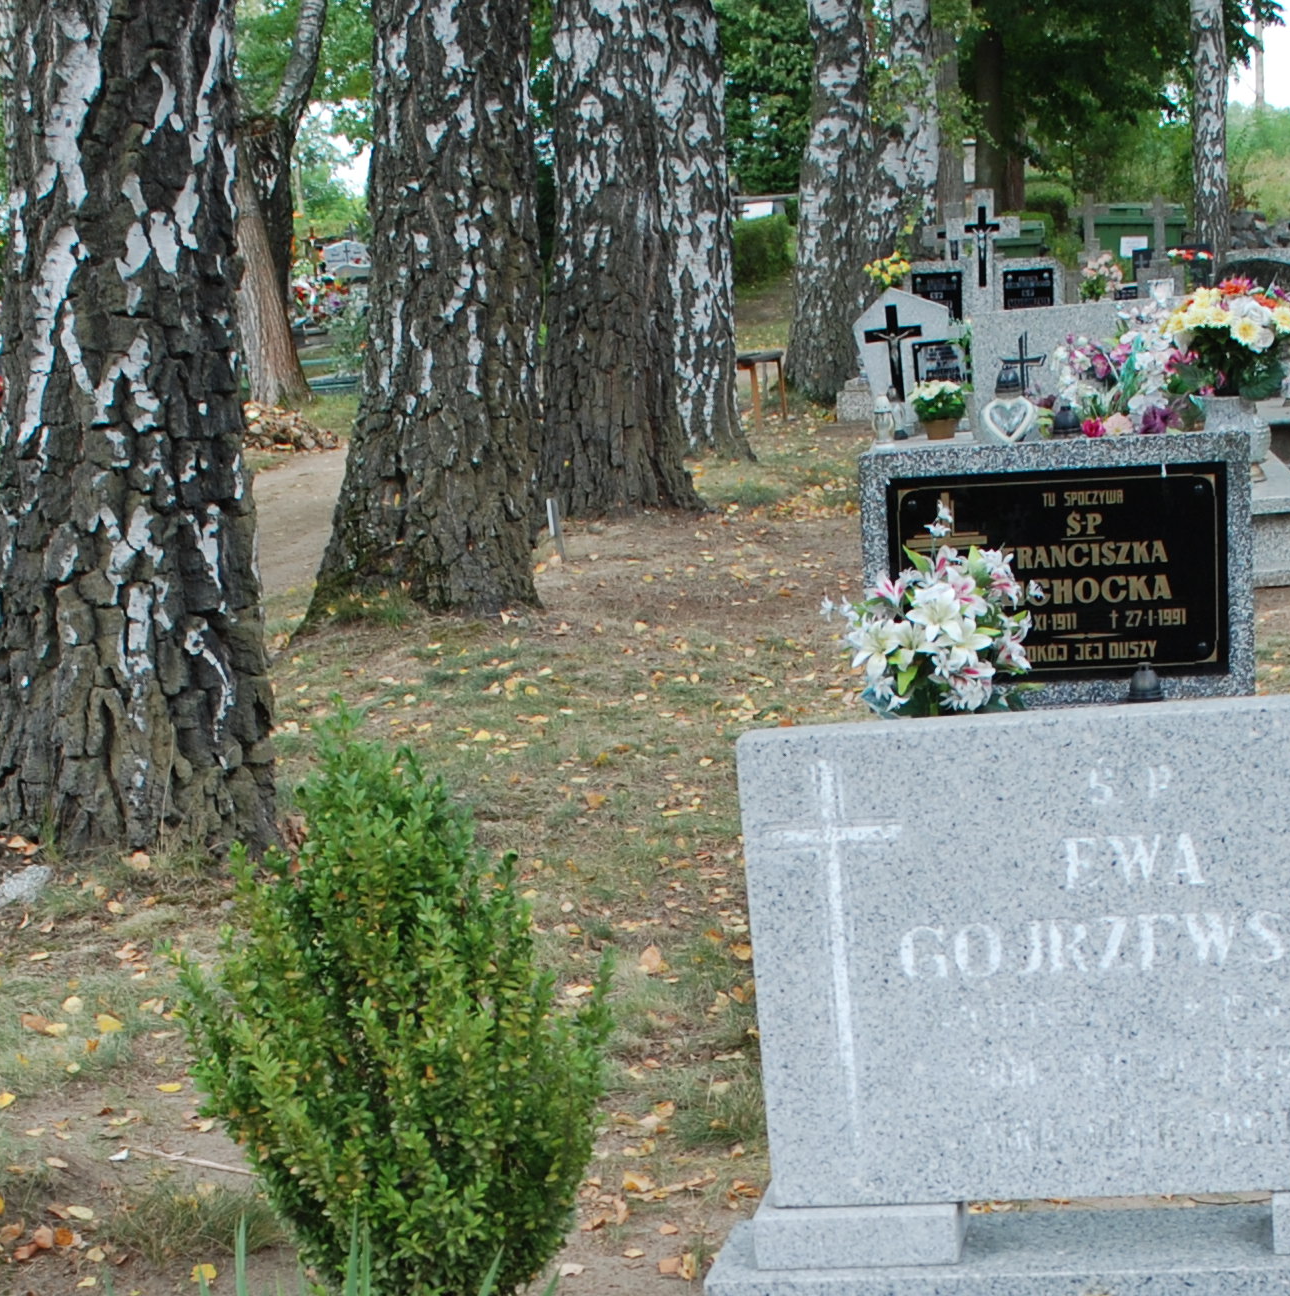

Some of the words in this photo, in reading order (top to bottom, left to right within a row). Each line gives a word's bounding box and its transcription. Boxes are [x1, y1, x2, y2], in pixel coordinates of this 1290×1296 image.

[1043, 493, 1056, 507] TU
[1064, 489, 1124, 506] SPOCZYWA
[1025, 642, 1068, 663] OKÓJ
[1075, 643, 1104, 661] JEJ
[1109, 640, 1158, 660] DUSZY
[1063, 833, 1207, 890] EWA
